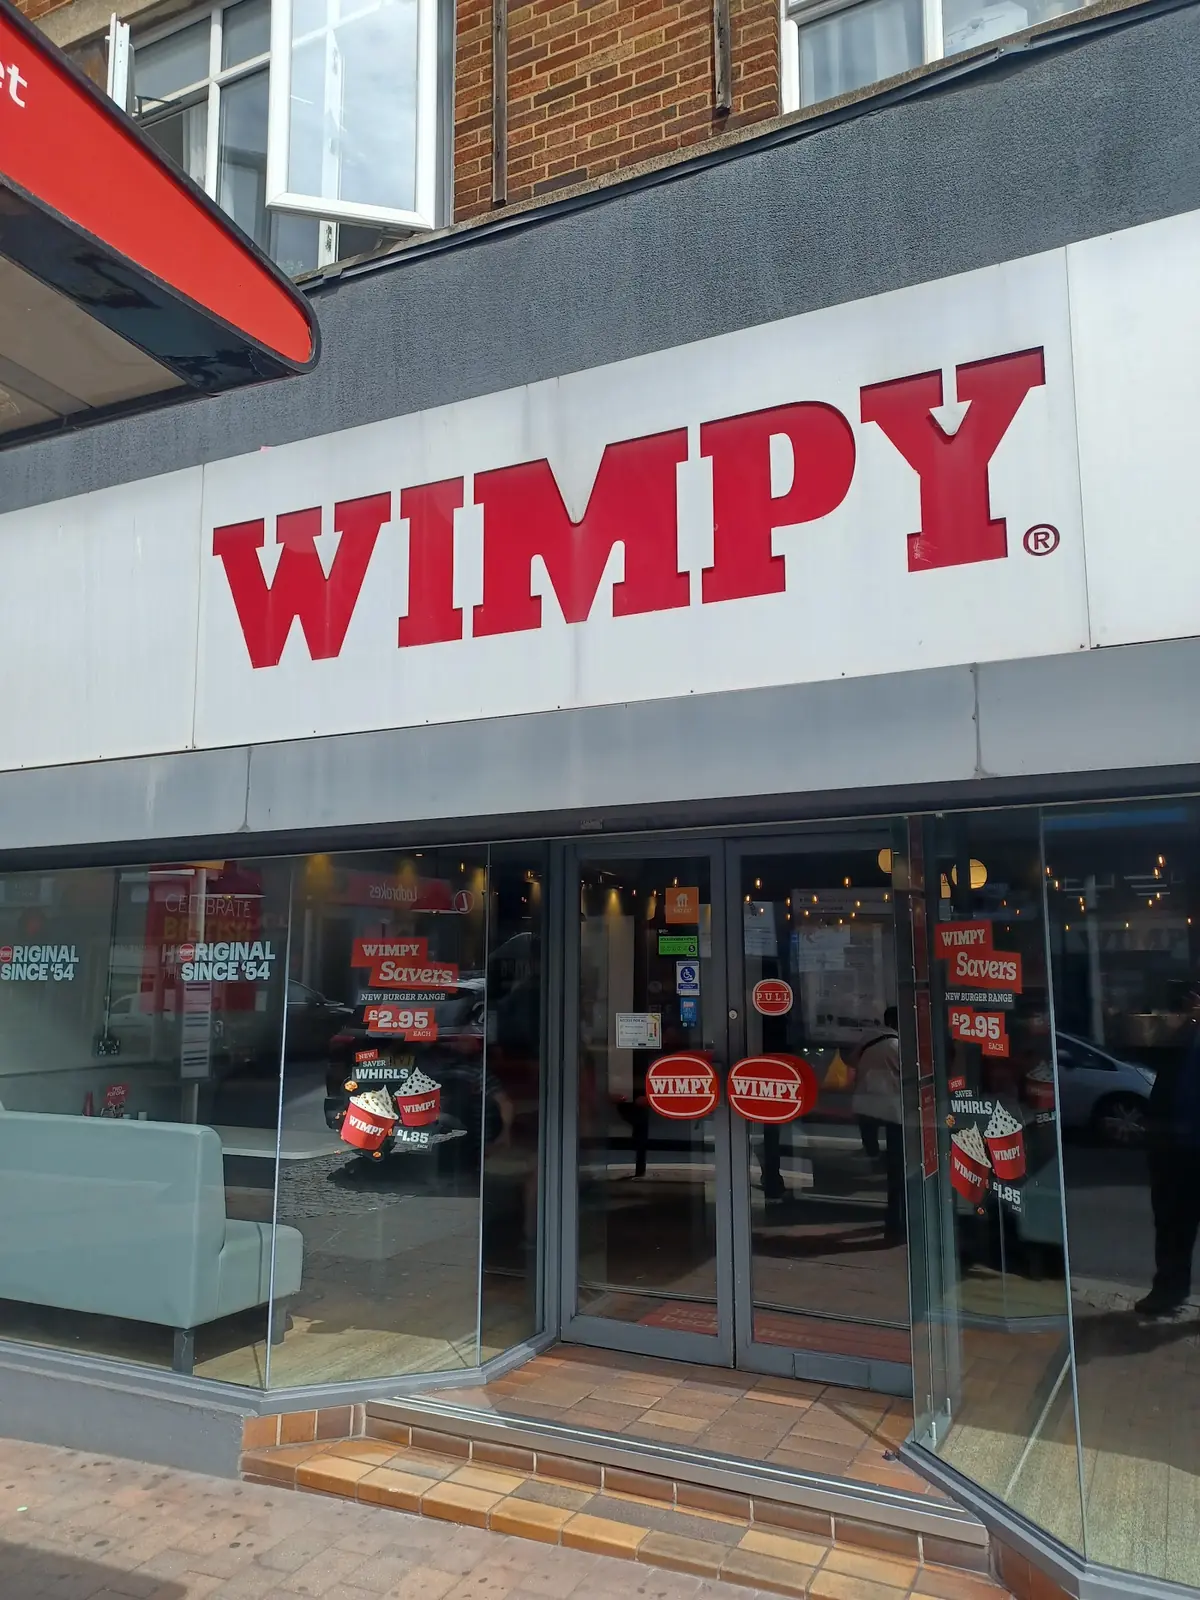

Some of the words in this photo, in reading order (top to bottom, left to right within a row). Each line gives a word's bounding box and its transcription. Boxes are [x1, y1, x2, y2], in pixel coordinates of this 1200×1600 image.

[212, 346, 1046, 670] WIMPY
[941, 929, 986, 946] WIMPY
[362, 944, 420, 957] WIMPY
[0, 963, 48, 981] SINCE
[181, 962, 239, 981] SINCE
[379, 961, 453, 984] Savers
[956, 952, 1017, 981] Savers
[361, 993, 381, 1001] NEW
[382, 993, 416, 1001] BURGER
[417, 993, 446, 1001] RANGE
[756, 992, 790, 1001] PULL
[945, 992, 960, 1001] NEW
[961, 993, 988, 1002] BURGER
[988, 993, 1013, 1003] RANGE
[368, 1010, 429, 1029] £2.95
[952, 1013, 1001, 1040] £2.95
[988, 1042, 1004, 1051] EACH
[358, 1052, 375, 1060] NEW
[356, 1068, 409, 1080] WHIRLS
[650, 1079, 714, 1095] WIMPY
[732, 1079, 801, 1099] WIMPY
[950, 1079, 963, 1088] NEW
[955, 1090, 973, 1098] SAVER
[403, 1100, 436, 1114] WIMPY
[951, 1100, 993, 1115] WHIRLS
[349, 1115, 385, 1137] WIMPY
[993, 1146, 1020, 1161] WIMPY
[953, 1157, 983, 1188] WIMPY
